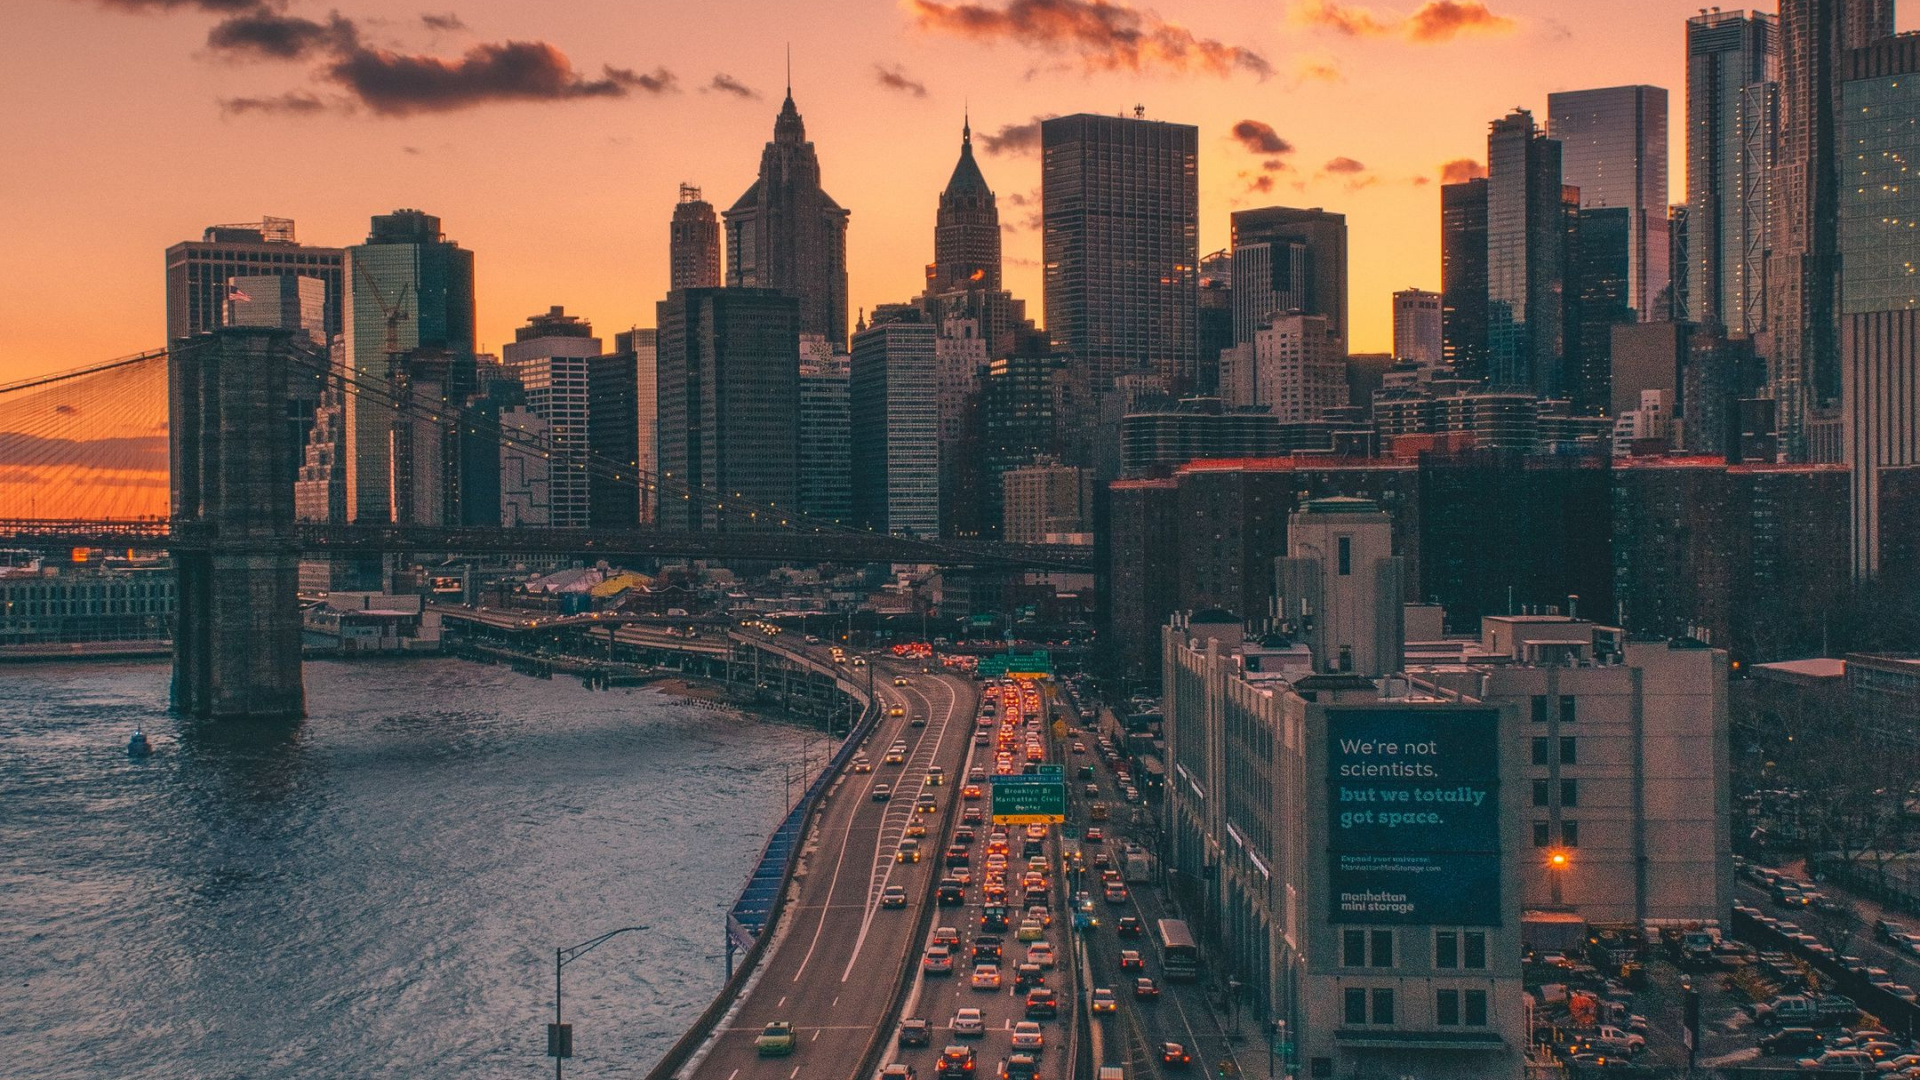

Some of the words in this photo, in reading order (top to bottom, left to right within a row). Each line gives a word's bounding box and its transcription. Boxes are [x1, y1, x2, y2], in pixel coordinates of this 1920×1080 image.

[1340, 738, 1398, 754] We're
[1405, 740, 1437, 755] not
[1340, 761, 1438, 777] scientists.
[1340, 786, 1376, 802] but
[1379, 790, 1409, 802] we
[1413, 786, 1486, 806] totally
[1340, 810, 1374, 828] got
[1378, 811, 1444, 828] space.
[1341, 855, 1371, 863] Expand
[1341, 888, 1407, 902] manhattan
[1341, 901, 1366, 911] mini
[1367, 902, 1414, 914] storage
